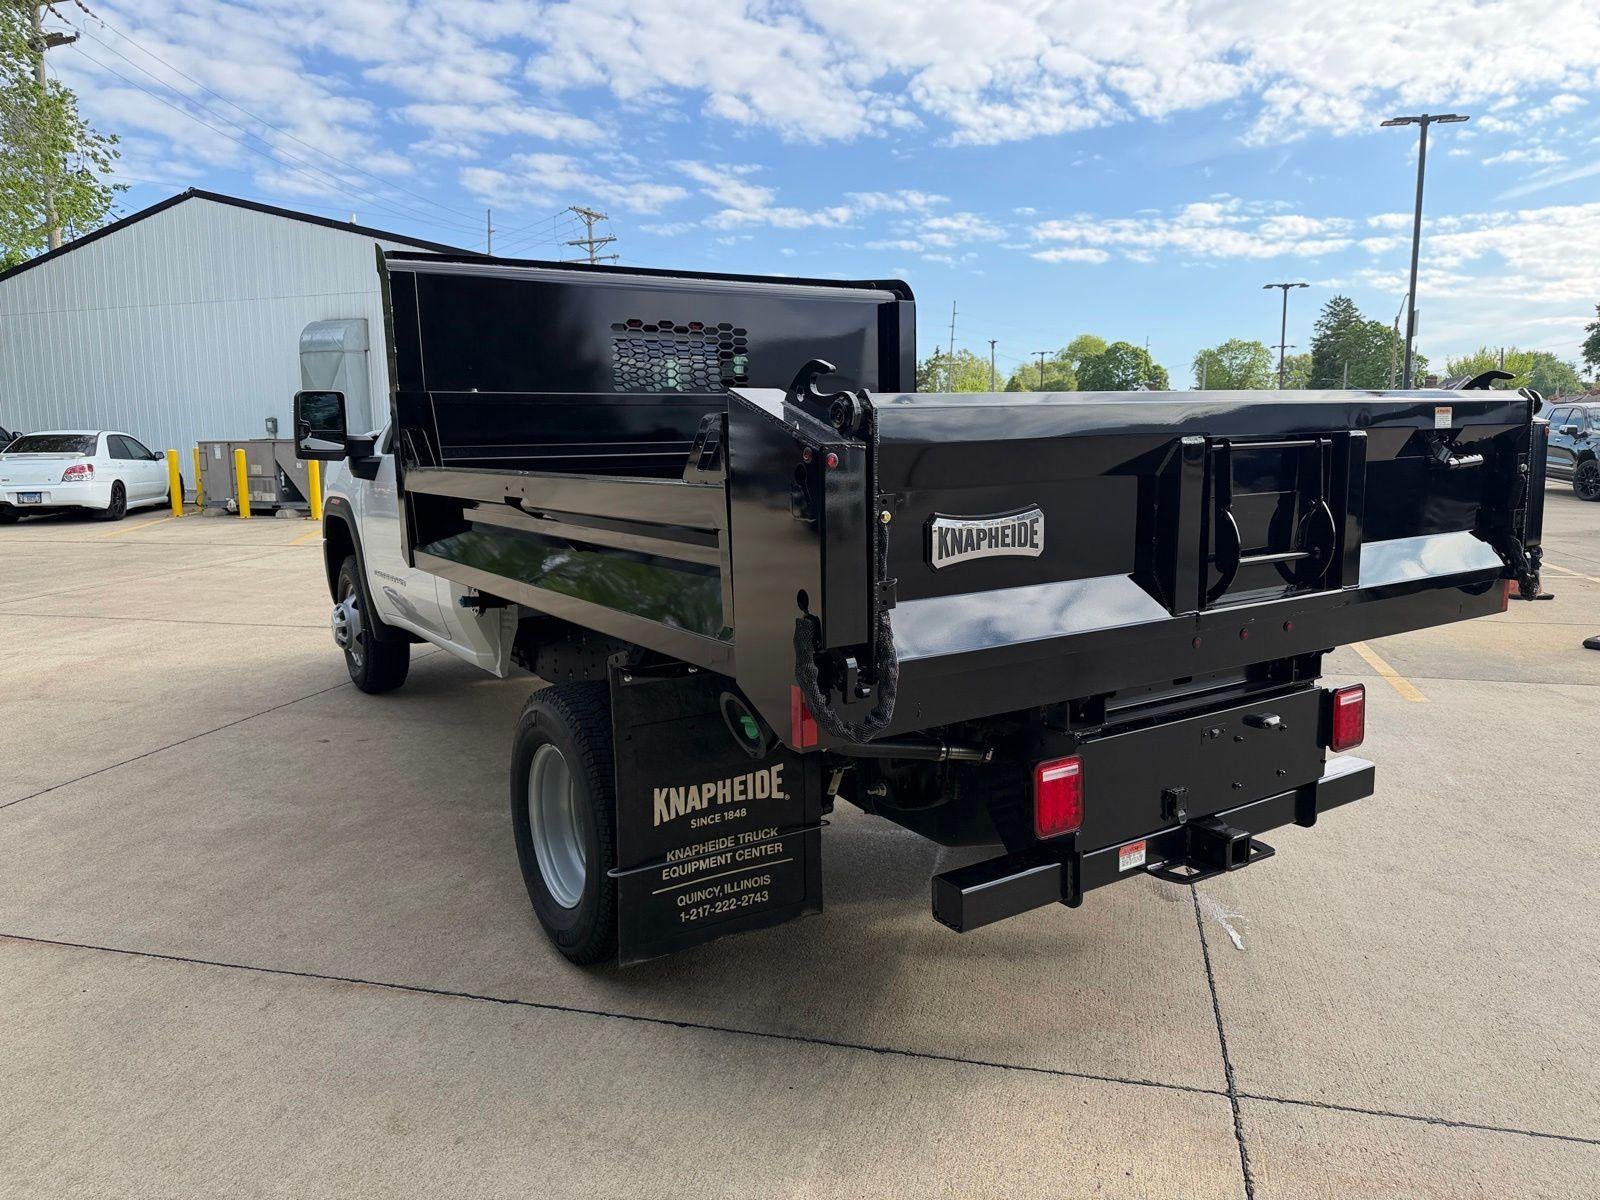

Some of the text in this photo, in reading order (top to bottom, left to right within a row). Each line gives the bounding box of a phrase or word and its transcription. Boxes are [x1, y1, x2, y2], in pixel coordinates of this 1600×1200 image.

[937, 517, 1040, 560] KNAPHEIDE
[653, 763, 786, 827] KNAPHEIDE
[690, 807, 747, 829] SINCE 1848
[662, 842, 783, 880] EQUIPMENT CENTER
[666, 827, 778, 862] KNAPHEIDE TRUCK
[677, 874, 771, 906] QUINCY, ILLINOIS
[680, 890, 769, 922] 1-217-222-2743
